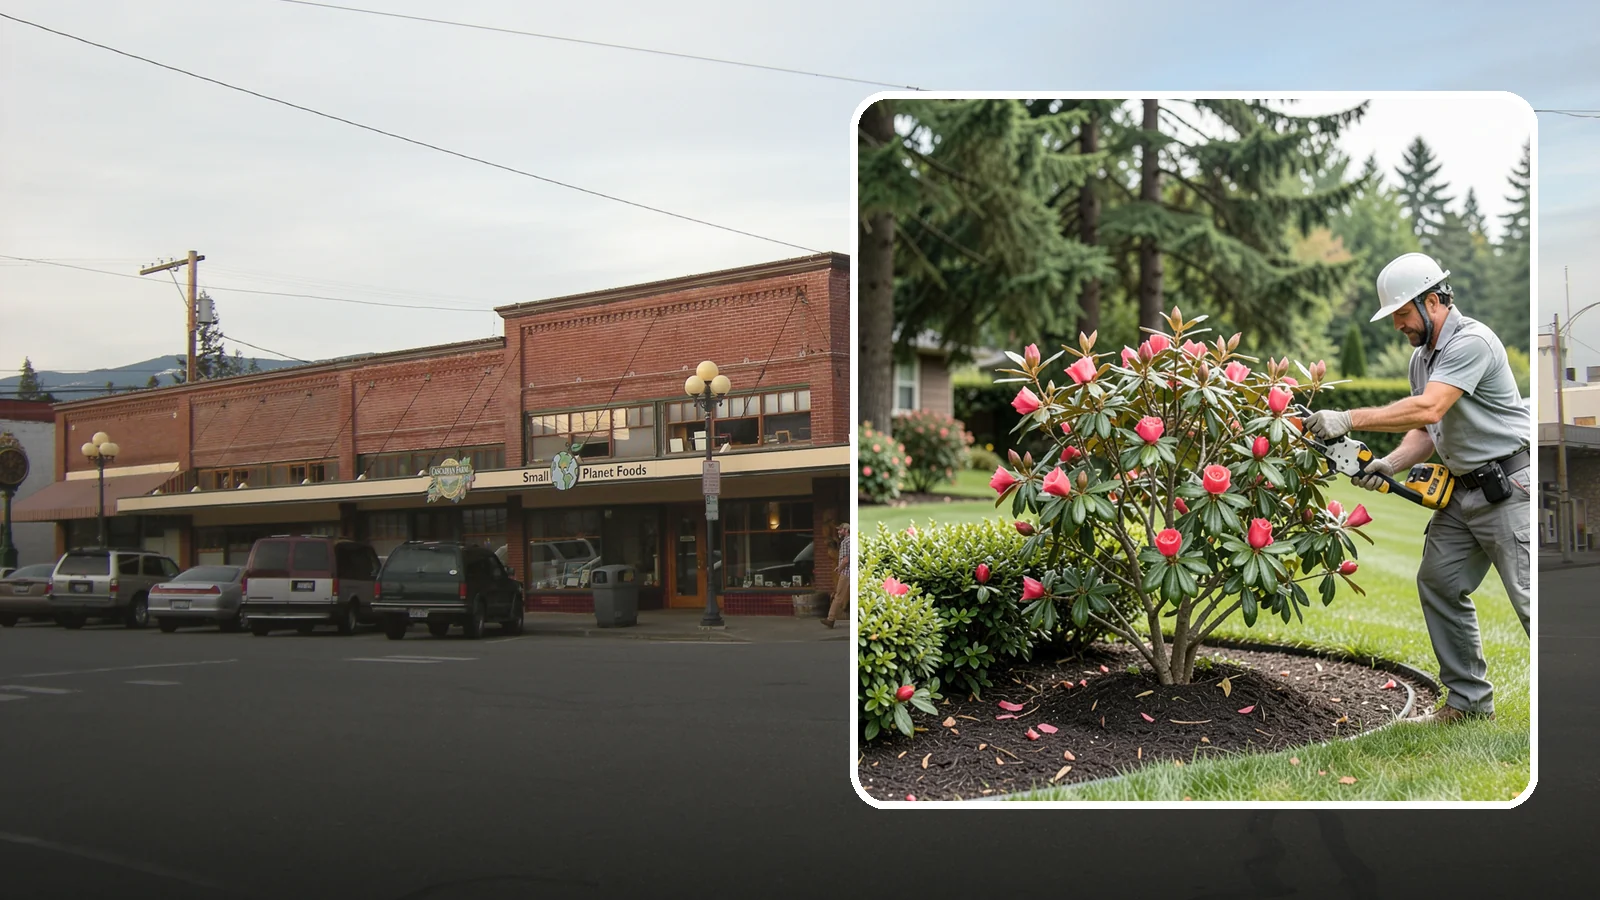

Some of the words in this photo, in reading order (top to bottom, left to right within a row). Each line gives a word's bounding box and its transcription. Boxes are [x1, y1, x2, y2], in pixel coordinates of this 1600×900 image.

[523, 471, 549, 483] Small
[583, 467, 614, 479] Planet
[617, 464, 647, 477] Foods
